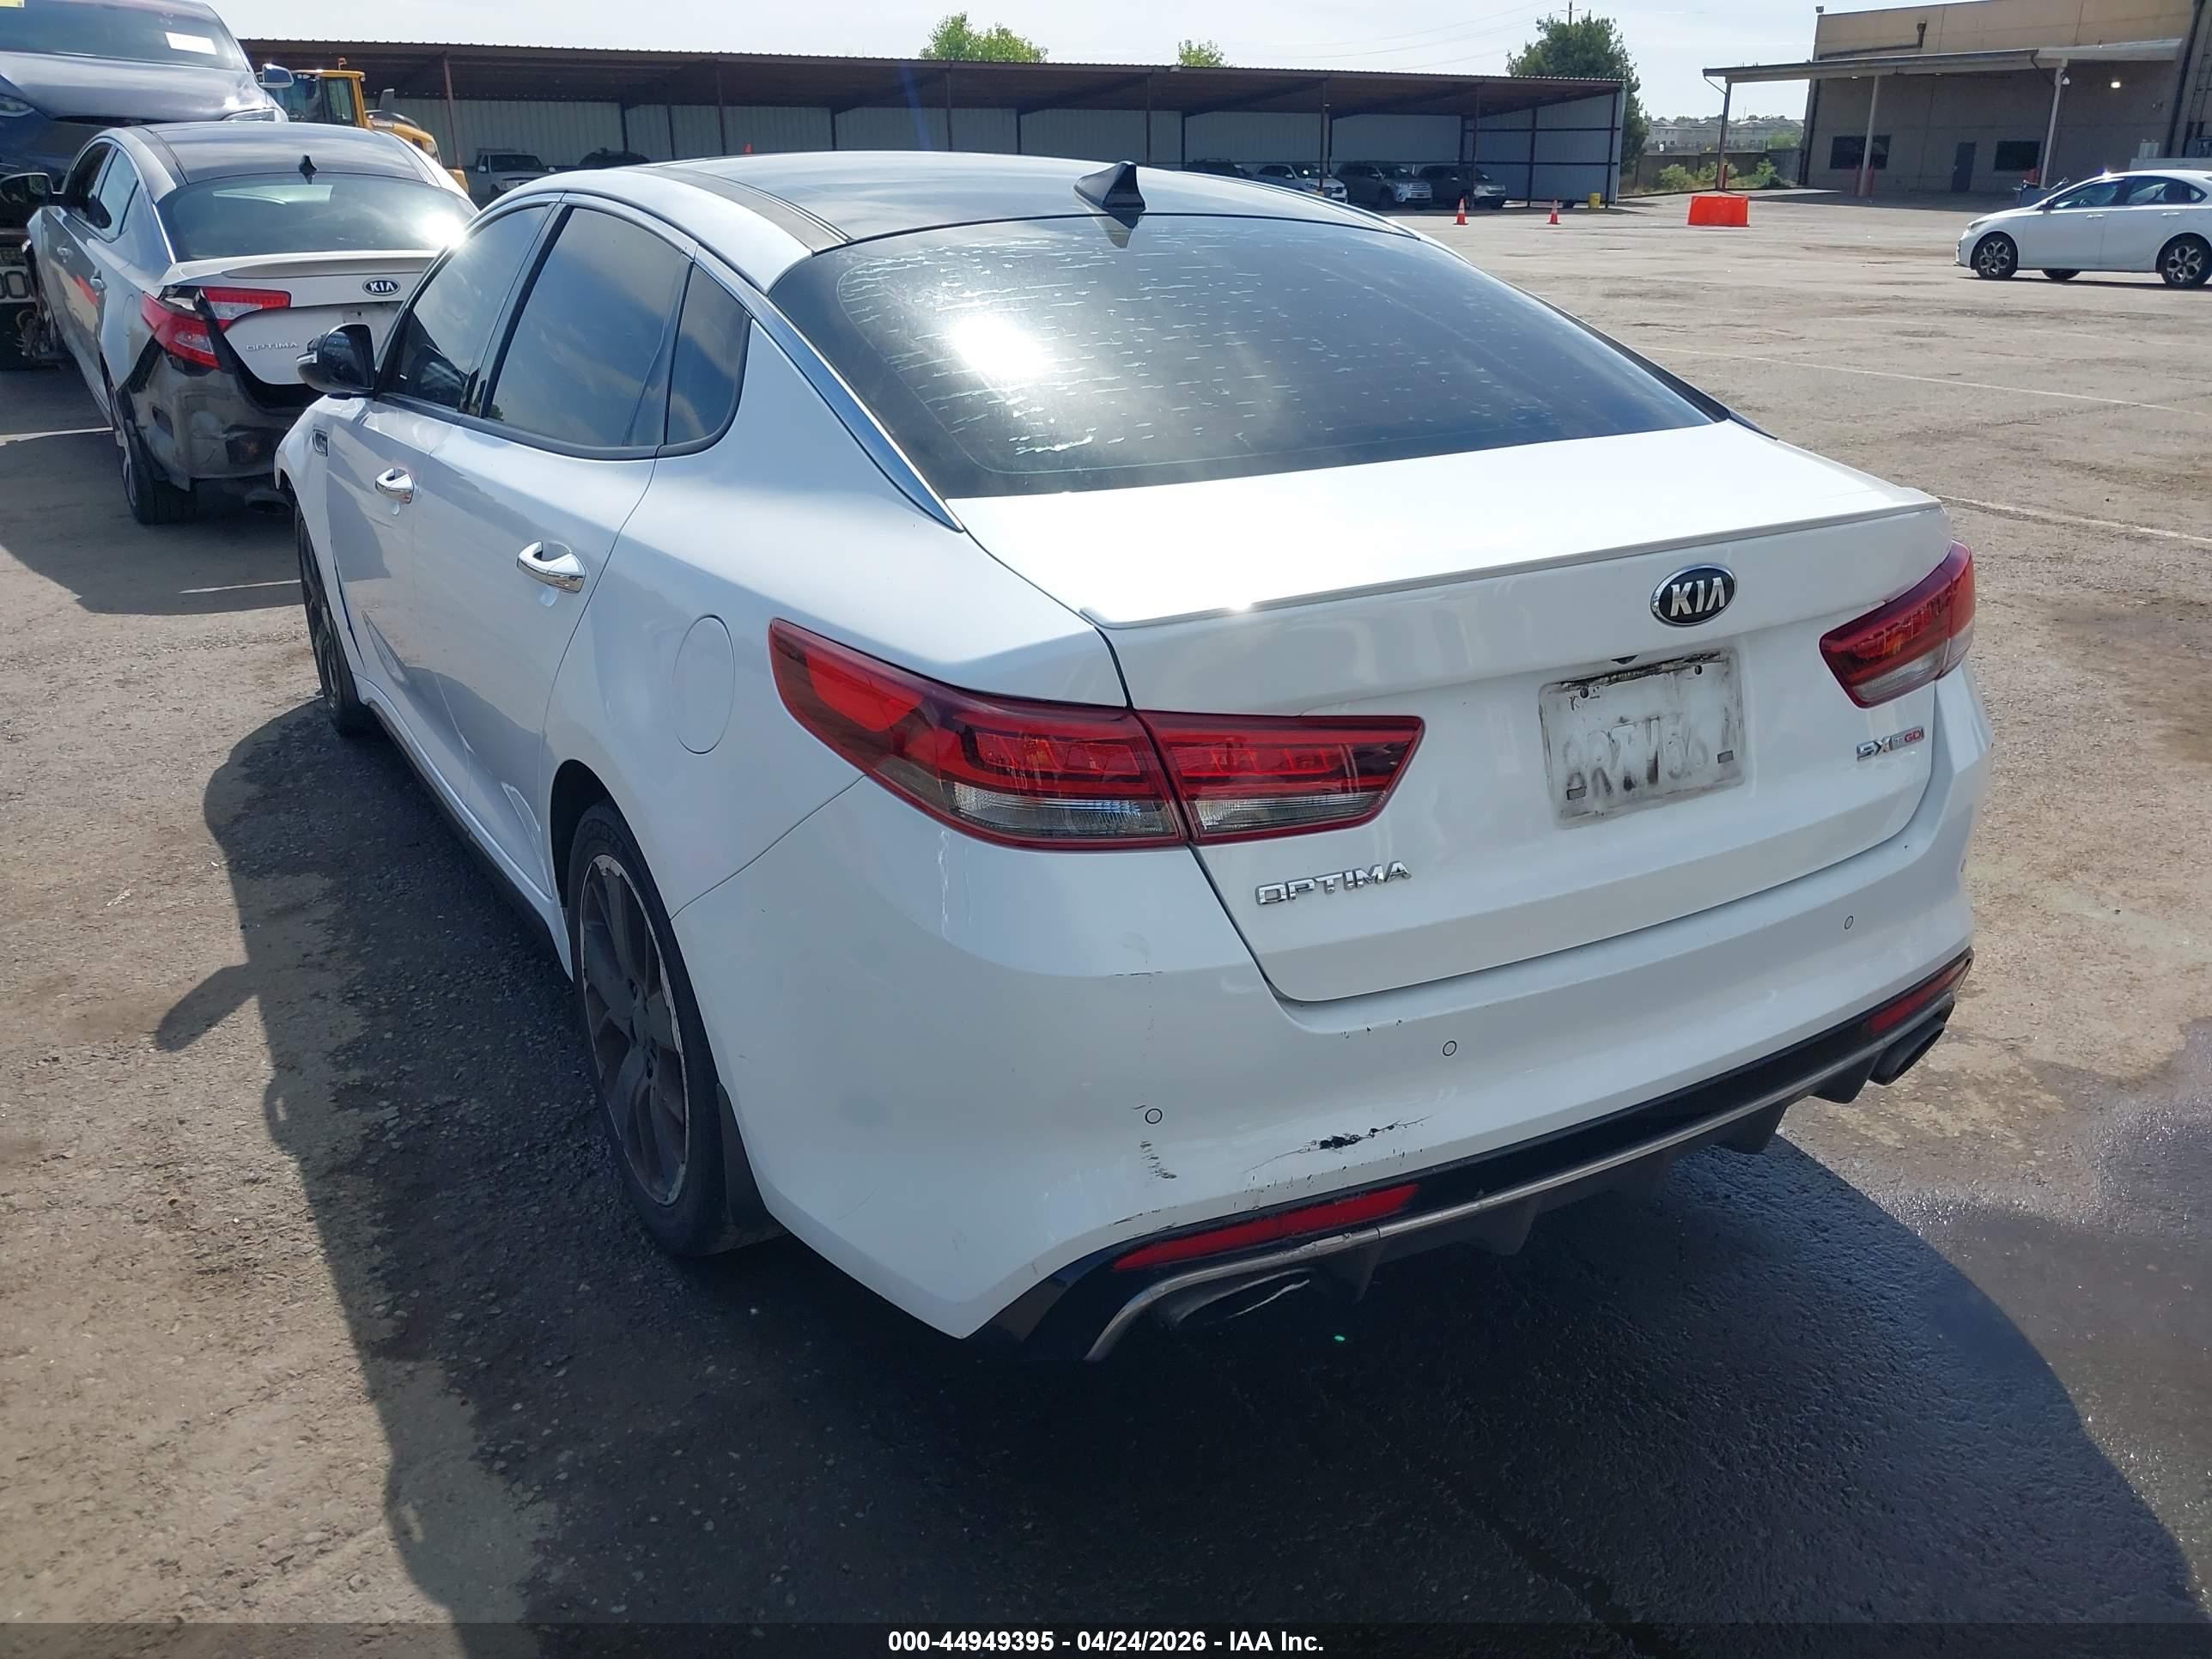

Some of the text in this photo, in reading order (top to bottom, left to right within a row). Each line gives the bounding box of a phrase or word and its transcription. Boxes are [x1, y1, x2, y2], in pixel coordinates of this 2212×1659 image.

[370, 282, 394, 292] KIA
[246, 342, 298, 351] OPTIMA
[1670, 576, 1725, 617] KIA
[1255, 860, 1412, 905] OPTIMA
